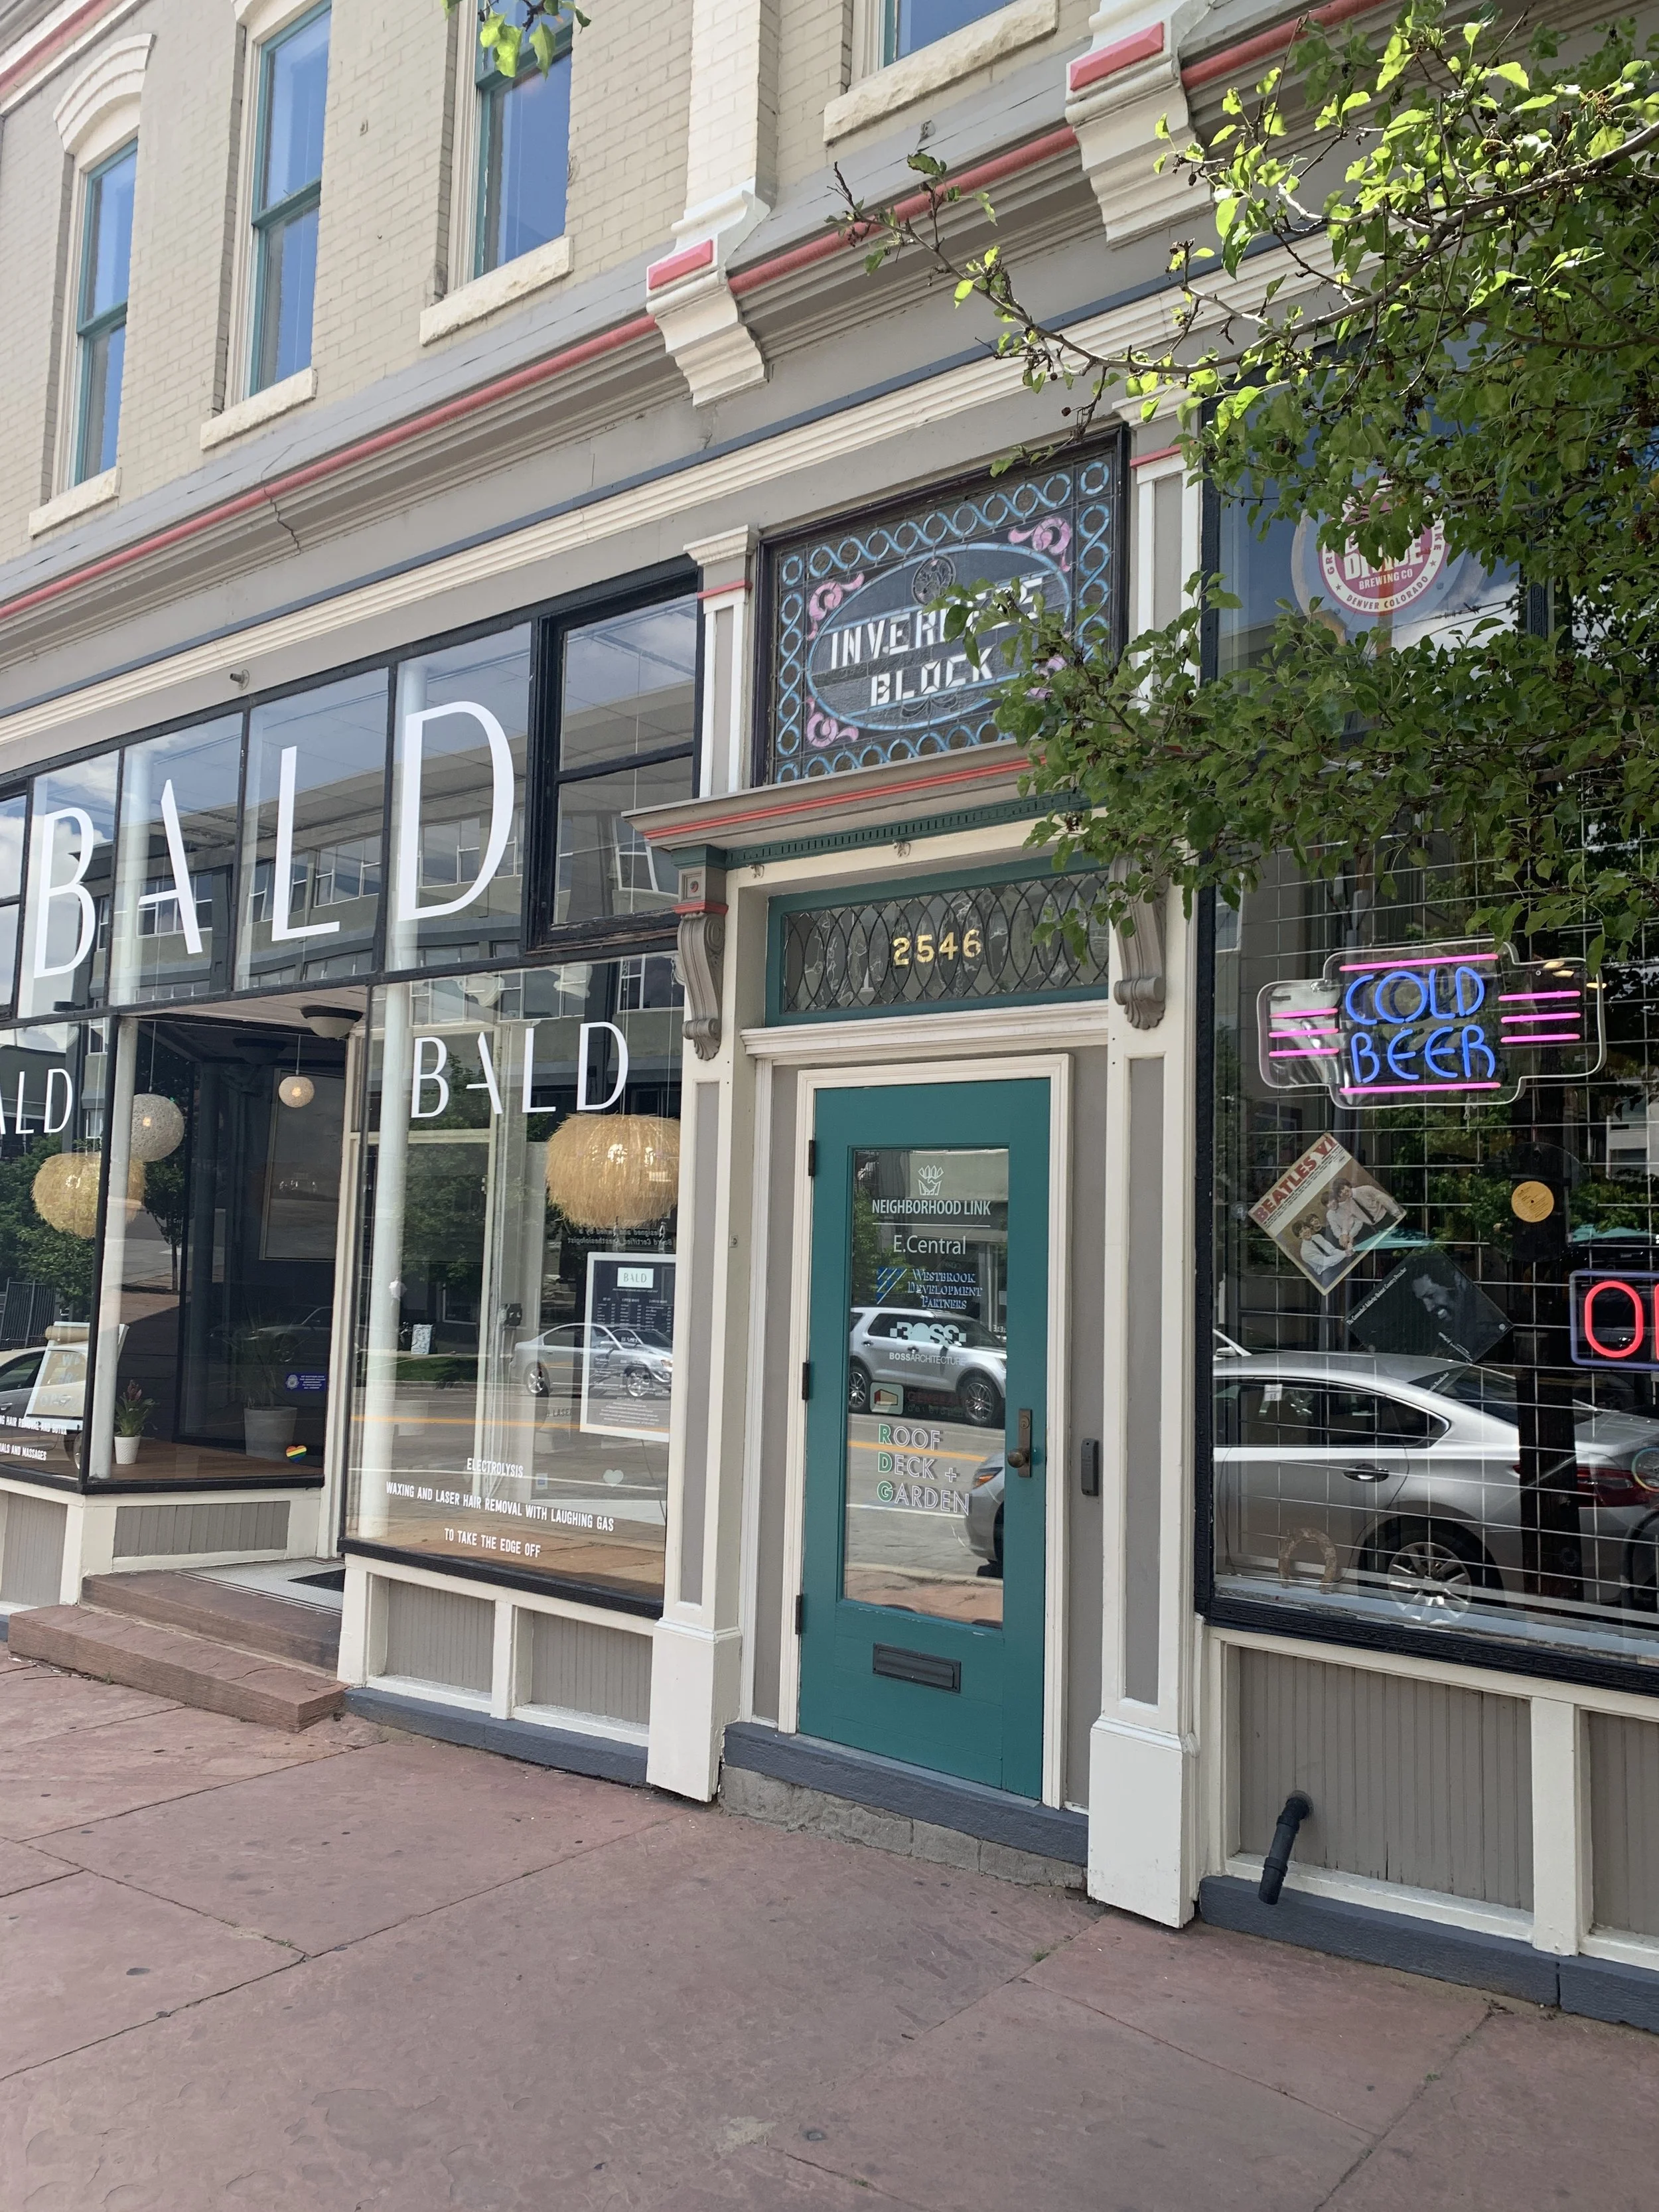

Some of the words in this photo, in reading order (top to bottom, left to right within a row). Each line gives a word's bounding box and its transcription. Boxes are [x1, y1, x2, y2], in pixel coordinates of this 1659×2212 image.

[1346, 594, 1380, 609] DENVER
[1384, 575, 1429, 609] COLORADO
[1359, 573, 1400, 590] BREWING
[1402, 568, 1413, 579] CO
[870, 646, 993, 707] BLOCK
[33, 701, 515, 979] BALD
[892, 929, 983, 966] 2546
[1344, 966, 1486, 1026] COLD
[1350, 1024, 1496, 1084] BEER
[411, 1021, 629, 1118] BALD
[1252, 1155, 1317, 1224] BEATLES
[1313, 1136, 1338, 1159] VI
[872, 1199, 962, 1215] NEIGHBORHOOD
[964, 1200, 991, 1216] LINK
[893, 1234, 966, 1255] E.Central
[623, 1272, 648, 1283] BALD
[908, 1282, 983, 1296] DEVELOPMENT
[912, 1268, 976, 1283] WESTBROOK
[921, 1296, 967, 1309] PARTNERS
[6, 1416, 17, 1427] HAIR
[879, 1424, 941, 1451] ROOF
[11, 1445, 21, 1456] AND
[22, 1447, 47, 1461] MASSAGES
[467, 1457, 524, 1478] ELECTROLYSIS
[877, 1451, 935, 1480] DECK
[386, 1481, 415, 1498] WAXING
[417, 1487, 433, 1501] AND
[435, 1489, 460, 1506] LASER
[463, 1494, 482, 1510] HAIR
[485, 1497, 522, 1516] REMOVAL
[525, 1504, 547, 1521] WITH
[551, 1508, 593, 1528] LAUGHING
[597, 1516, 614, 1532] GAS
[877, 1481, 970, 1516] GARDEN
[444, 1528, 455, 1542] TO
[457, 1530, 477, 1546] TAKE
[480, 1534, 497, 1550] THE
[500, 1538, 522, 1555] EDGE
[524, 1542, 541, 1558] OFF
